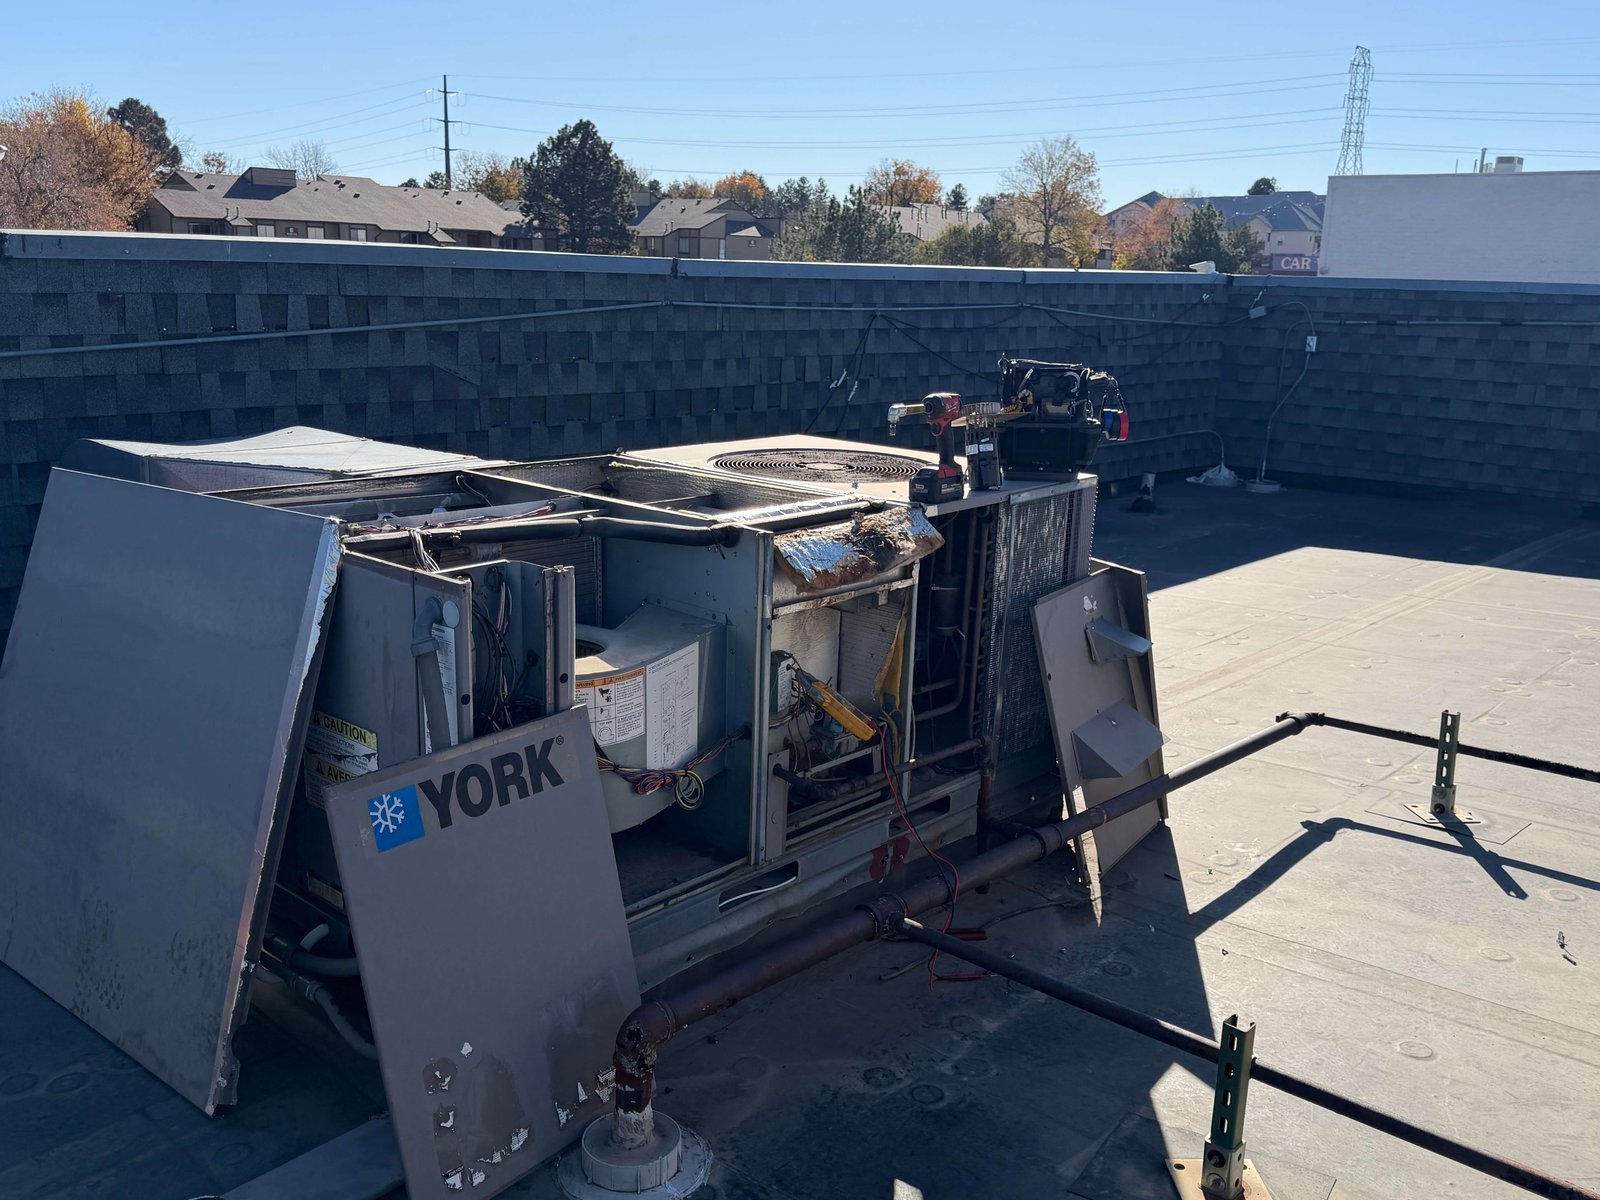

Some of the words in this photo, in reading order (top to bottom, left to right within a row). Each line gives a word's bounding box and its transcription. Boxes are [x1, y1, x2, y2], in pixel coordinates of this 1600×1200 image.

[1280, 256, 1311, 270] CAR
[323, 716, 367, 744] CAUTION
[327, 766, 353, 783] AVER
